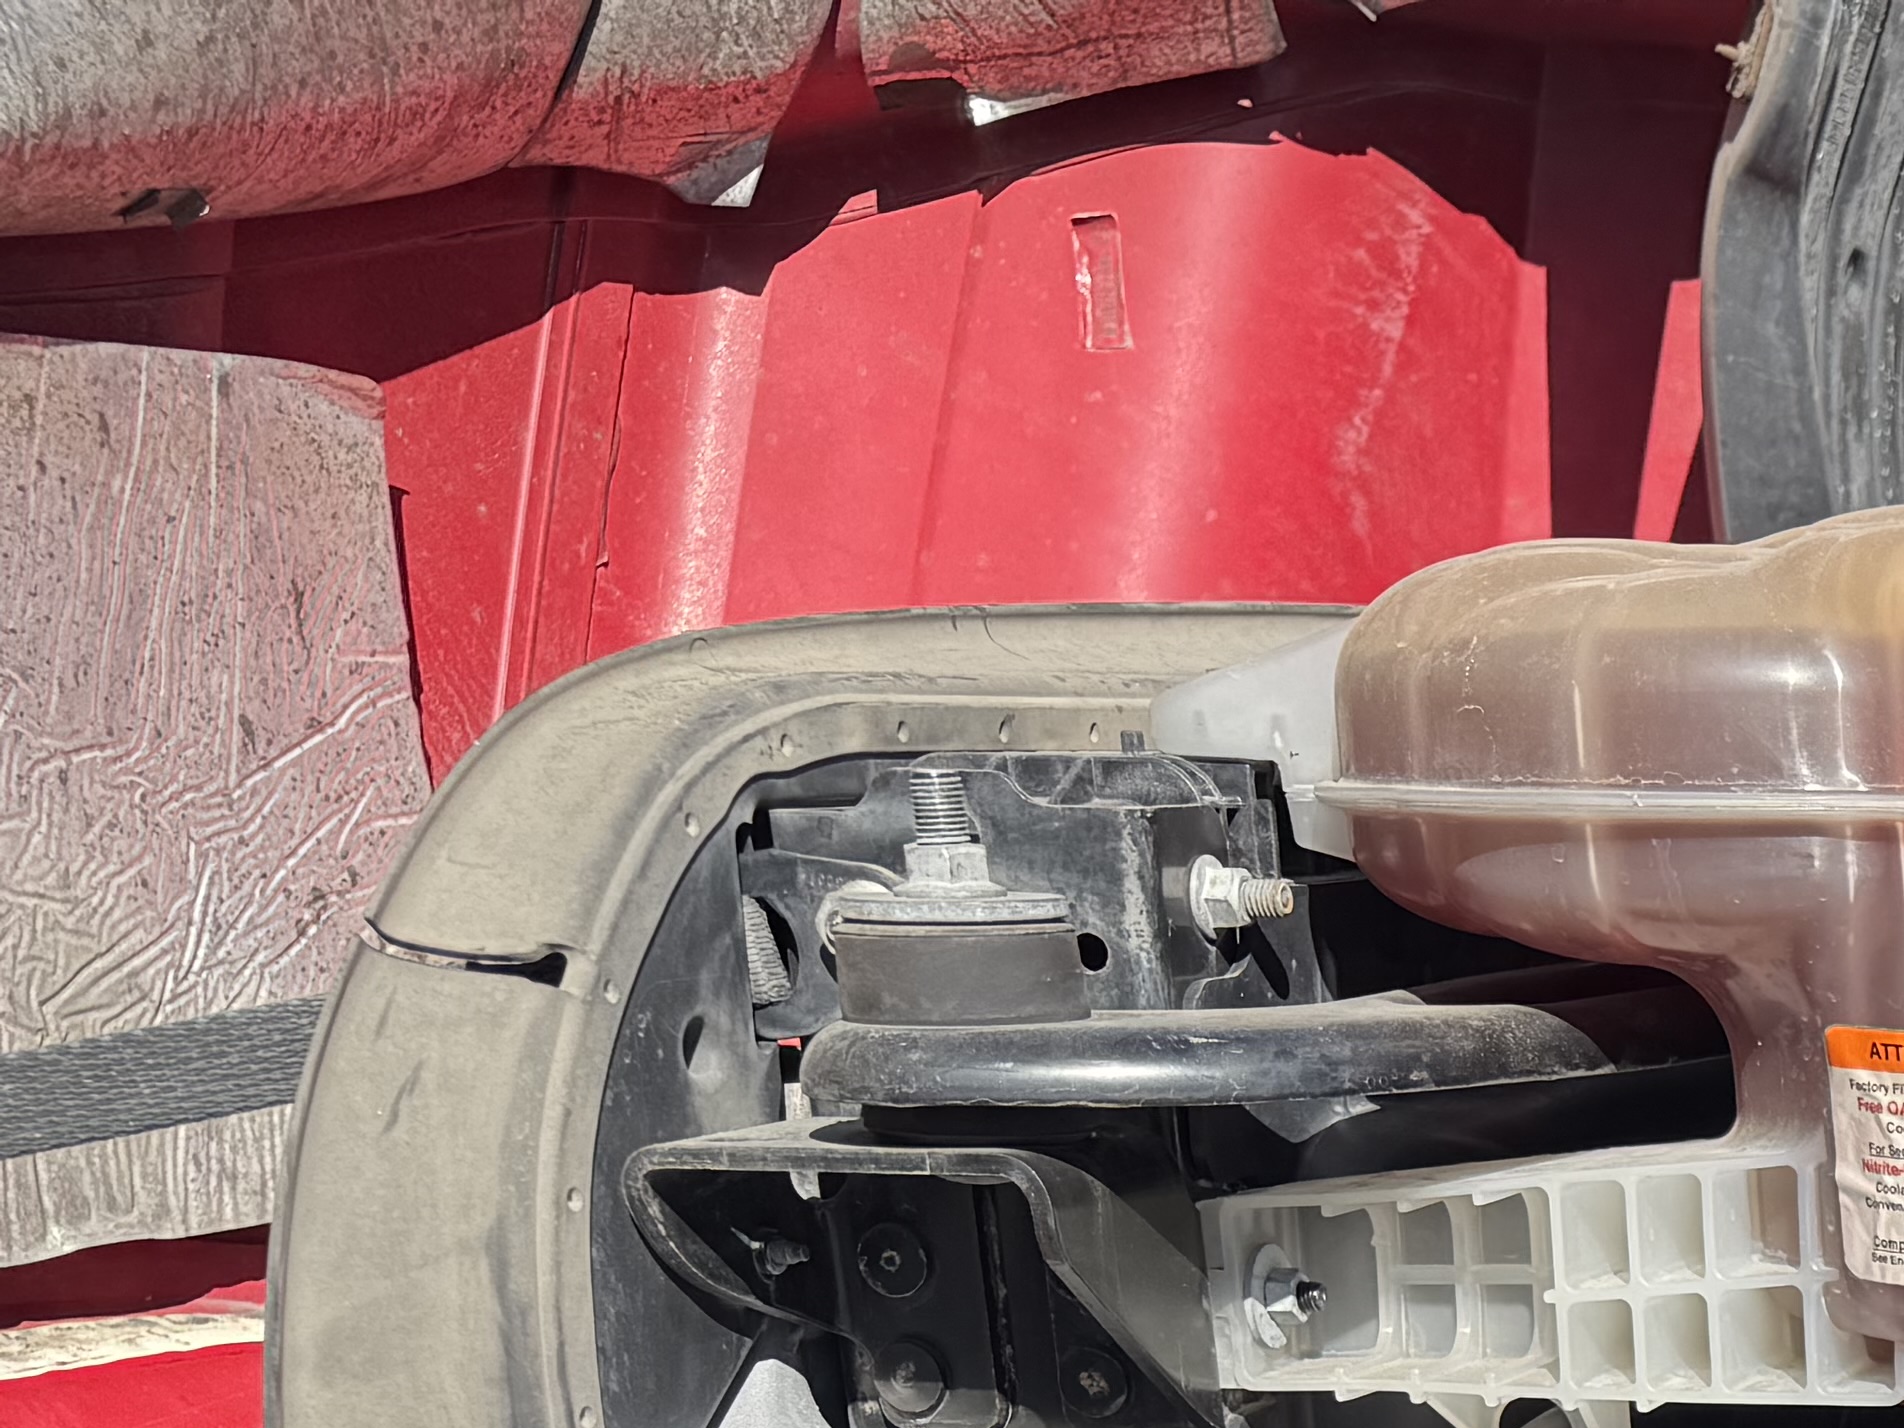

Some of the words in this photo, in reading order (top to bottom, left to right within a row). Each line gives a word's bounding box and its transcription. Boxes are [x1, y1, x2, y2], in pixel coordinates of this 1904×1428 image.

[1850, 1079, 1889, 1096] Factory
[1858, 1098, 1883, 1113] Free
[1869, 1142, 1886, 1157] For
[1872, 1252, 1888, 1264] See
